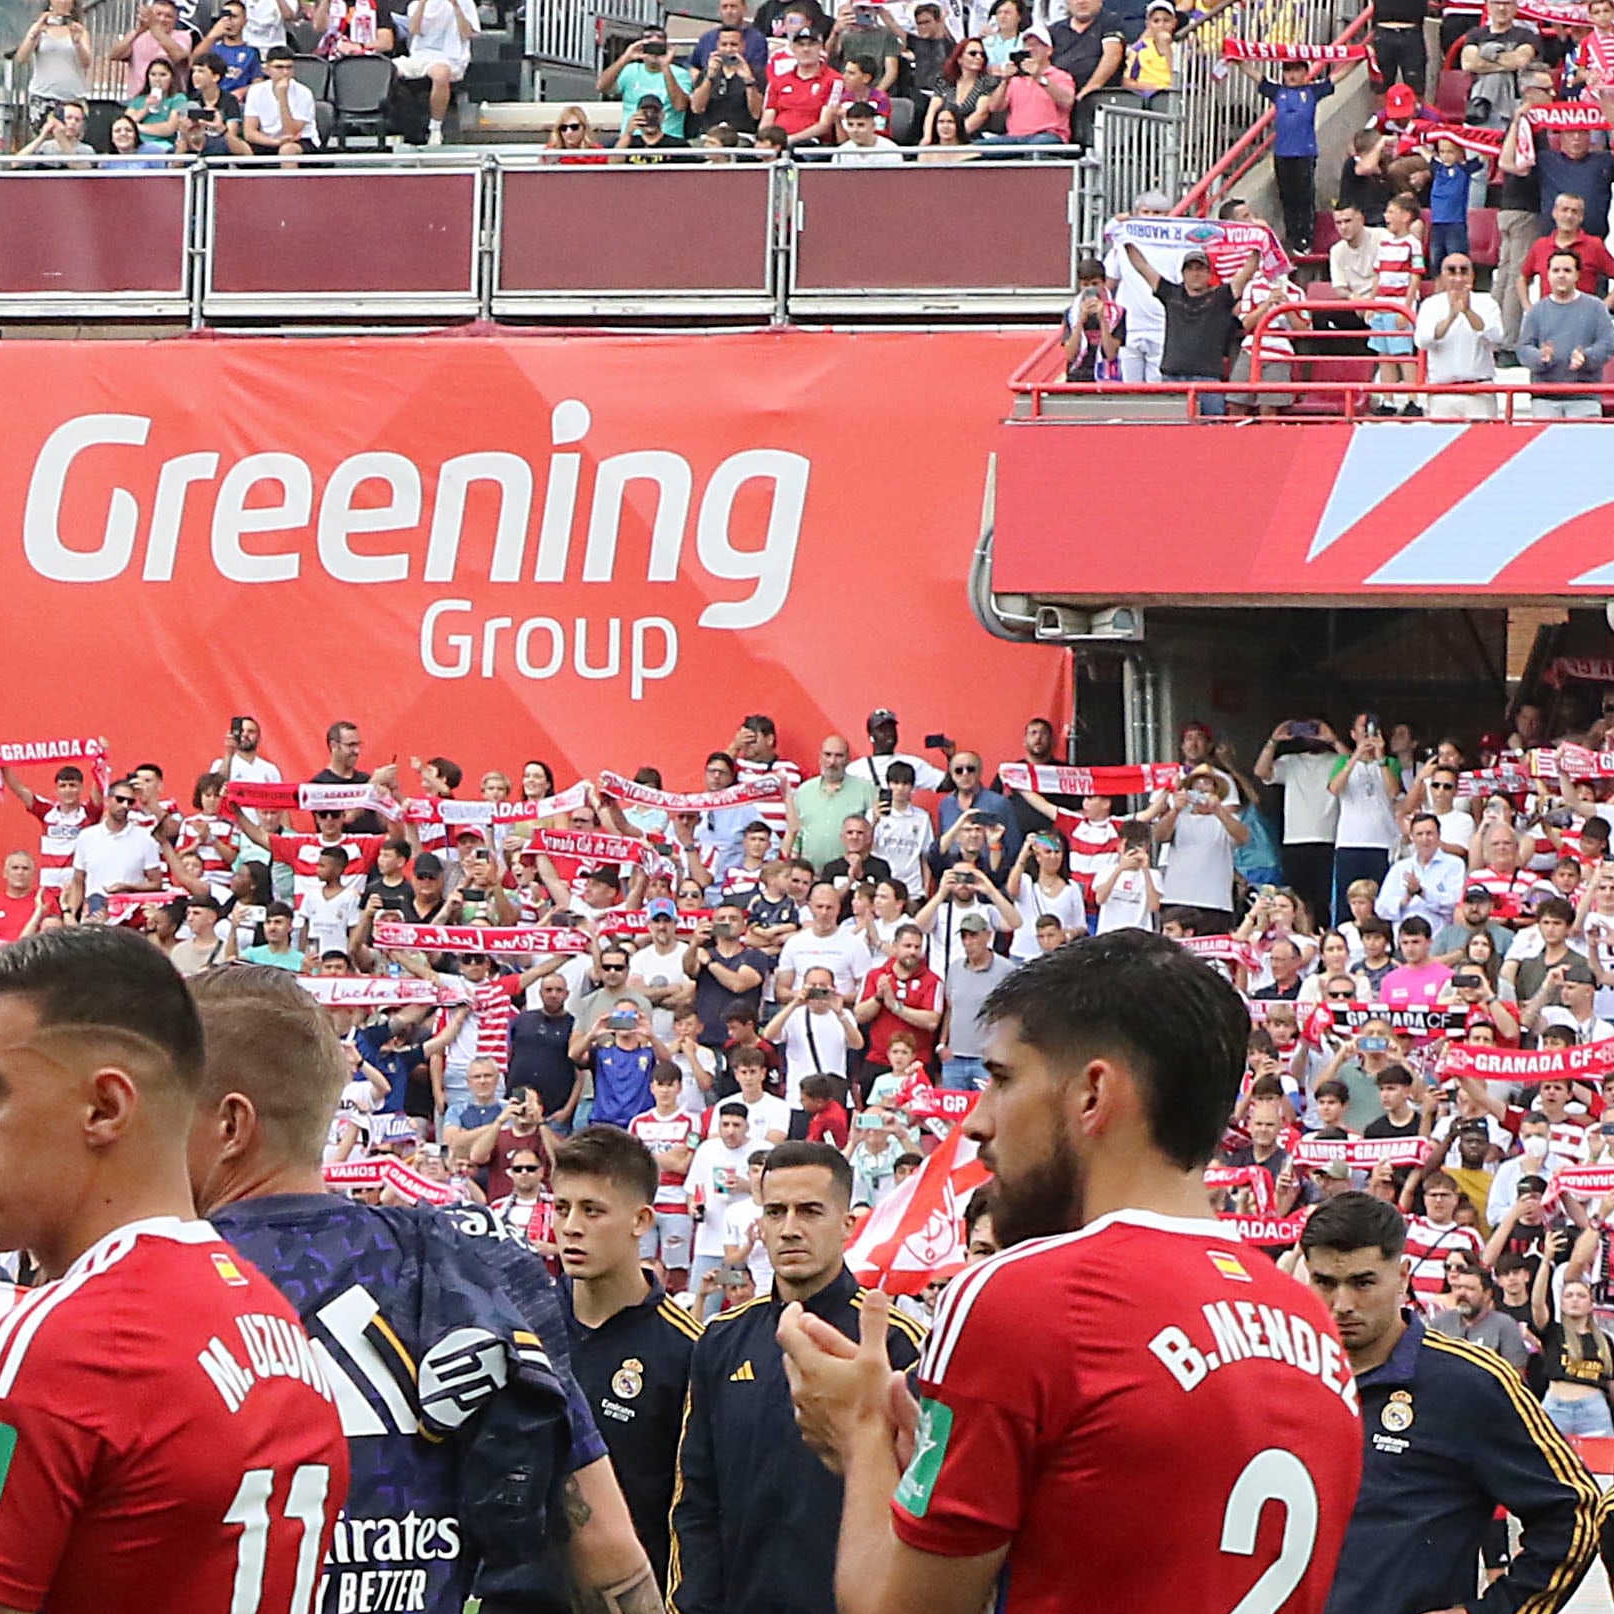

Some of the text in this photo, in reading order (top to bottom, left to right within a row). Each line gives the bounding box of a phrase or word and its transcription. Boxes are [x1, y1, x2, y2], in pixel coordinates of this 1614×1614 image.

[23, 399, 810, 629] Greening
[419, 598, 679, 700] Group
[0, 740, 83, 760] GRANADA
[329, 983, 396, 1002] Lucha
[1474, 1048, 1596, 1073] GRANADA CF
[330, 1165, 376, 1179] VAMOS
[338, 1568, 427, 1614] BETTER
